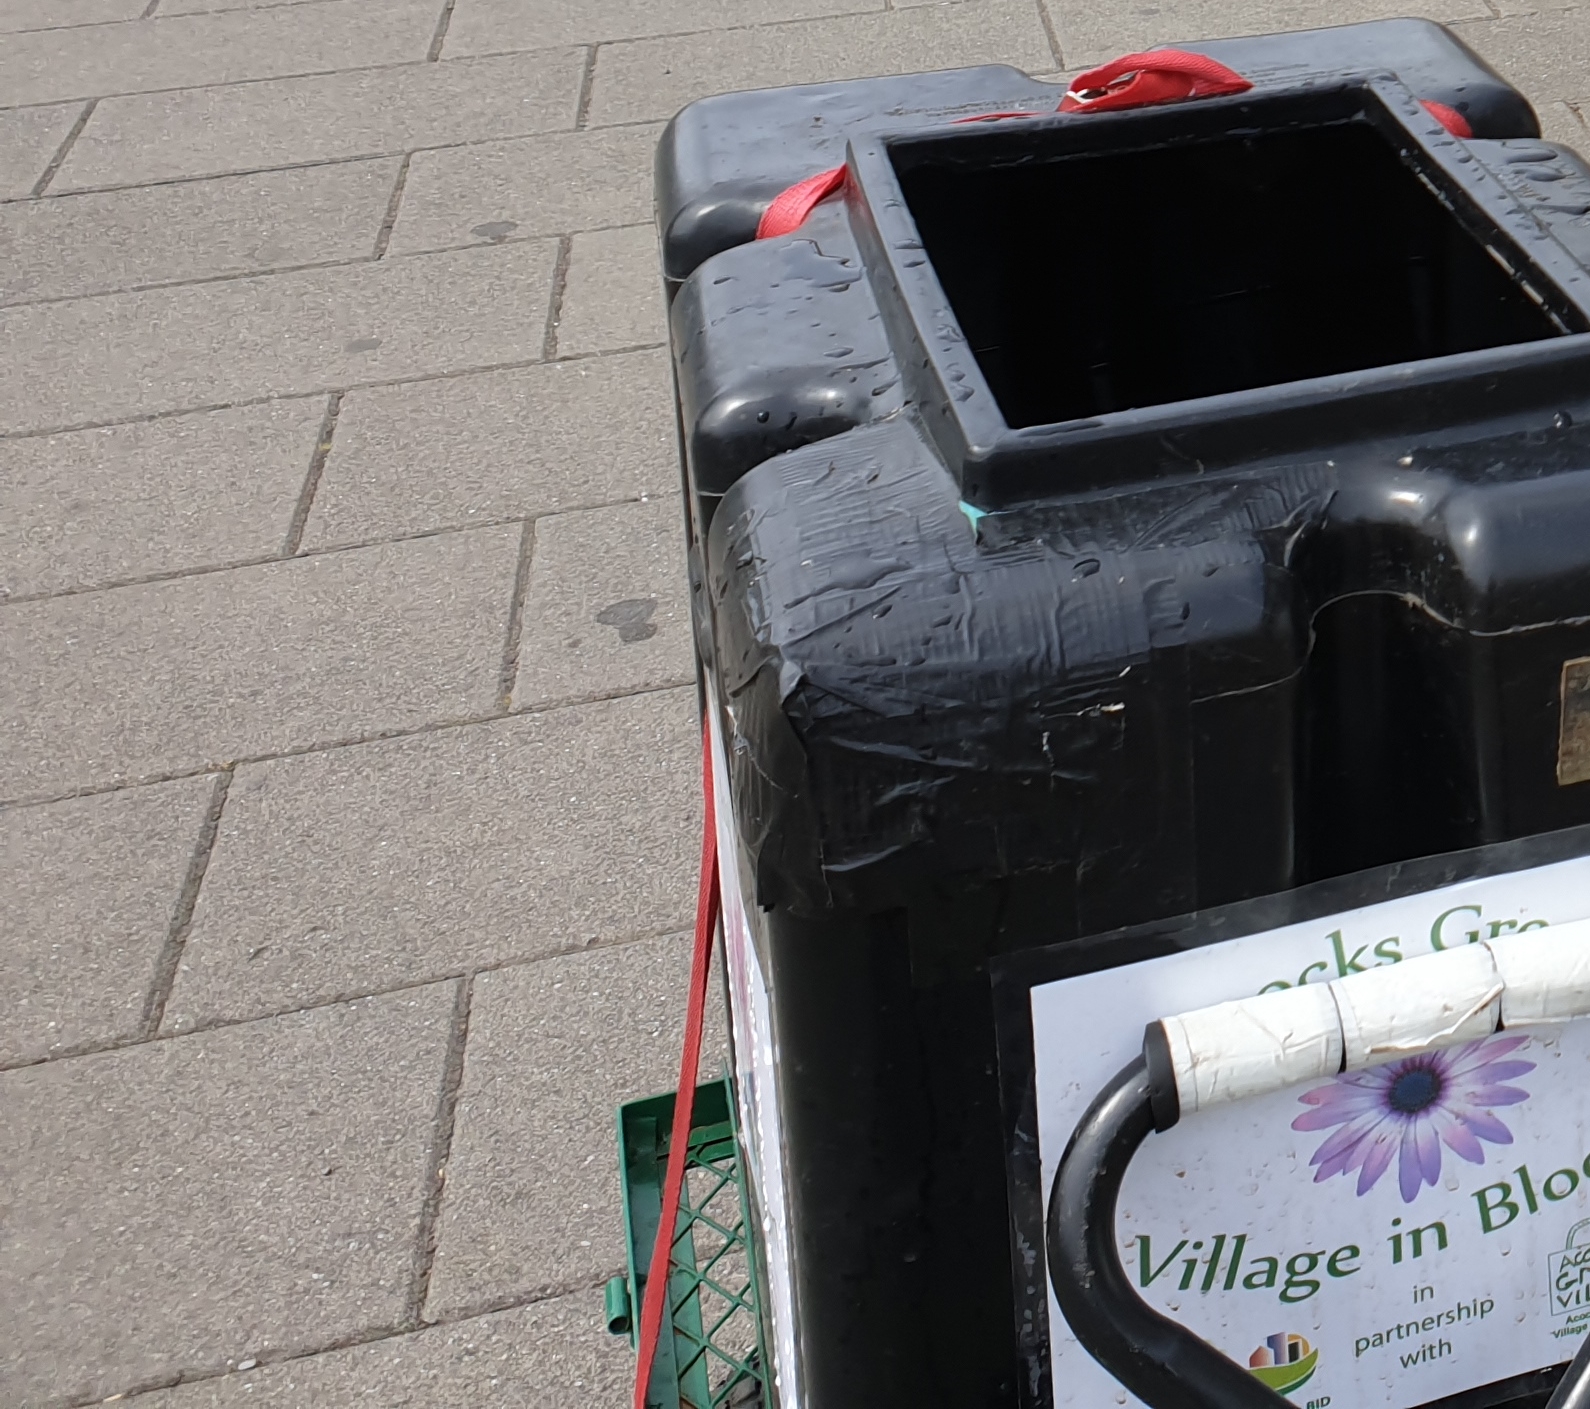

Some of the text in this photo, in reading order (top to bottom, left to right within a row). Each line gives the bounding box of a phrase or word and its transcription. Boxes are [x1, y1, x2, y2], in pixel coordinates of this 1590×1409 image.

[1135, 1233, 1361, 1304] Village
[1387, 1217, 1449, 1266] in
[1412, 1284, 1434, 1304] in
[1355, 1298, 1495, 1358] partnership
[1551, 1322, 1588, 1339] Village
[1399, 1338, 1452, 1369] with
